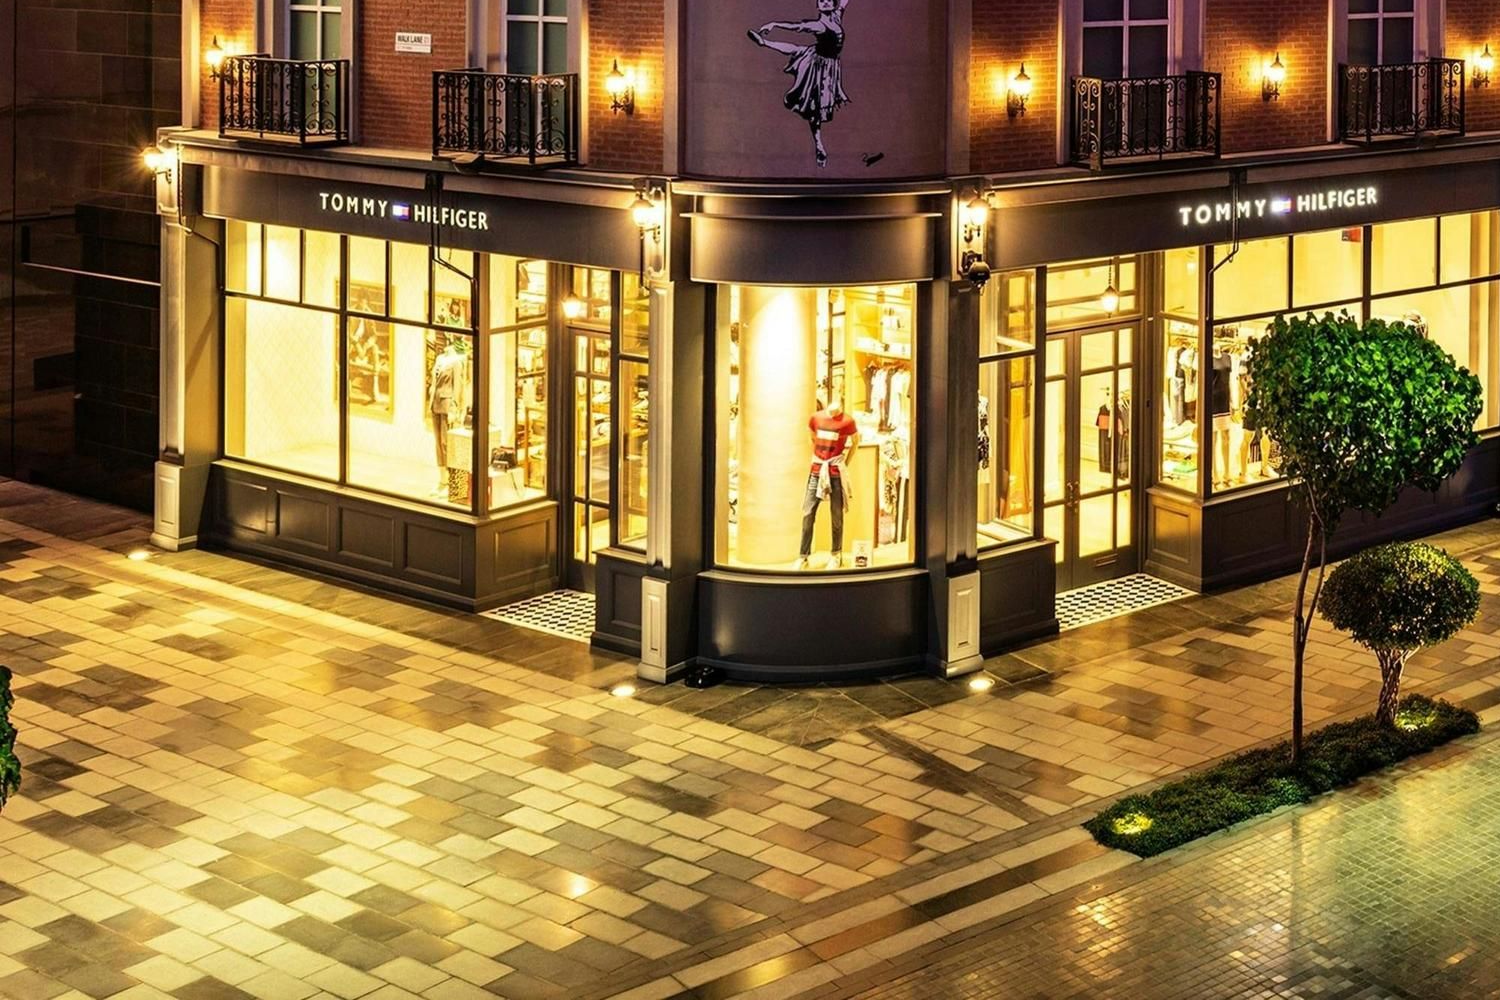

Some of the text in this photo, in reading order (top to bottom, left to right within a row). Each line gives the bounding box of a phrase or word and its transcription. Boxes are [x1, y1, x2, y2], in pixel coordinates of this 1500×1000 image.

[319, 192, 489, 231] TOMMY HILFIGER
[1178, 186, 1378, 226] TOMMY HILFIGER
